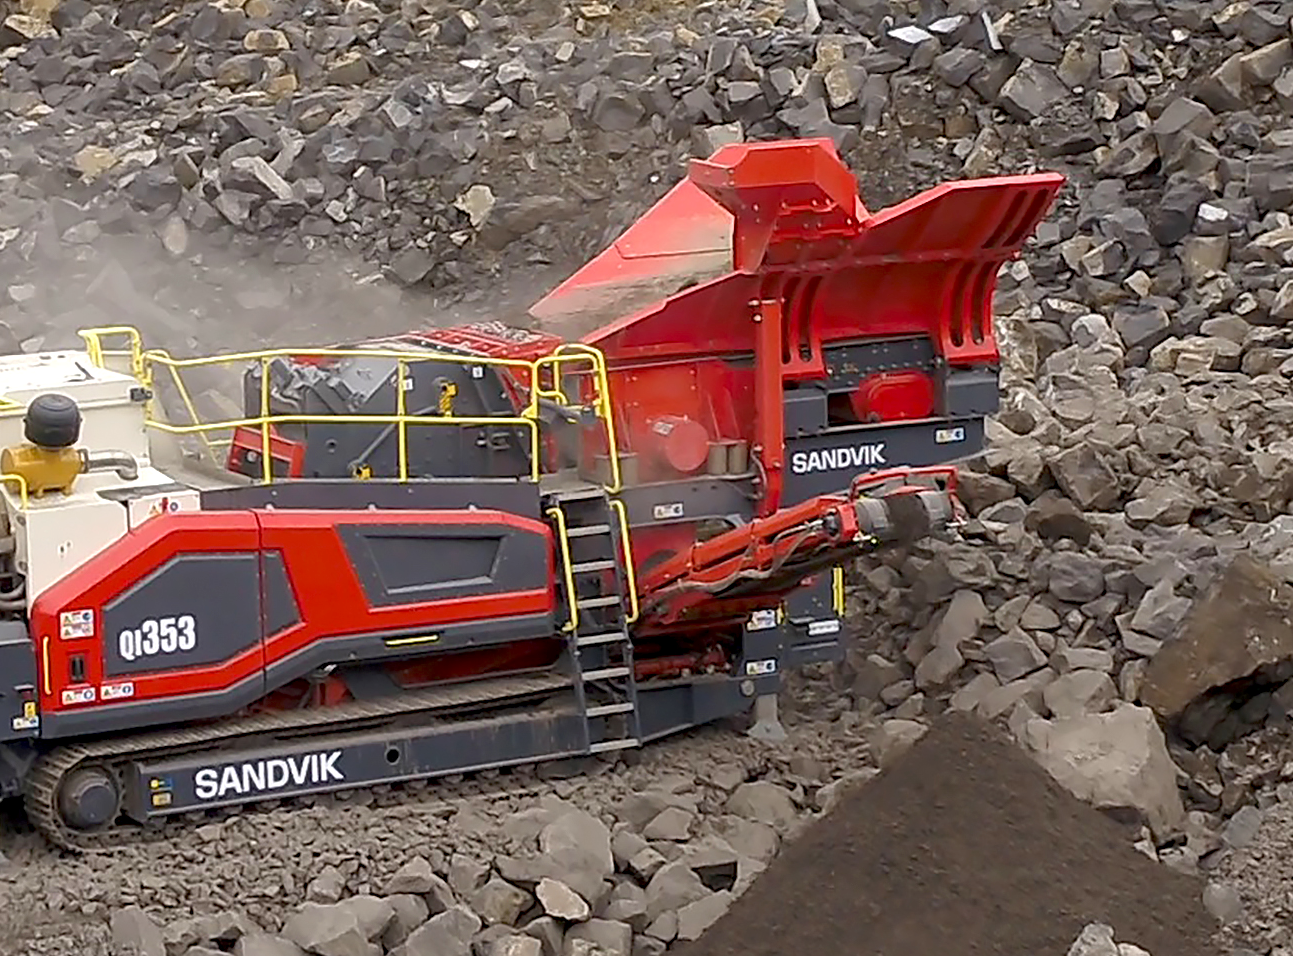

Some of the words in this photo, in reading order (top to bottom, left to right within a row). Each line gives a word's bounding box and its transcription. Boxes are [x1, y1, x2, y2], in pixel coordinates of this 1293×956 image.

[792, 443, 886, 473] SANDVIK
[119, 615, 196, 661] QI353
[195, 751, 344, 799] SANDVIK
